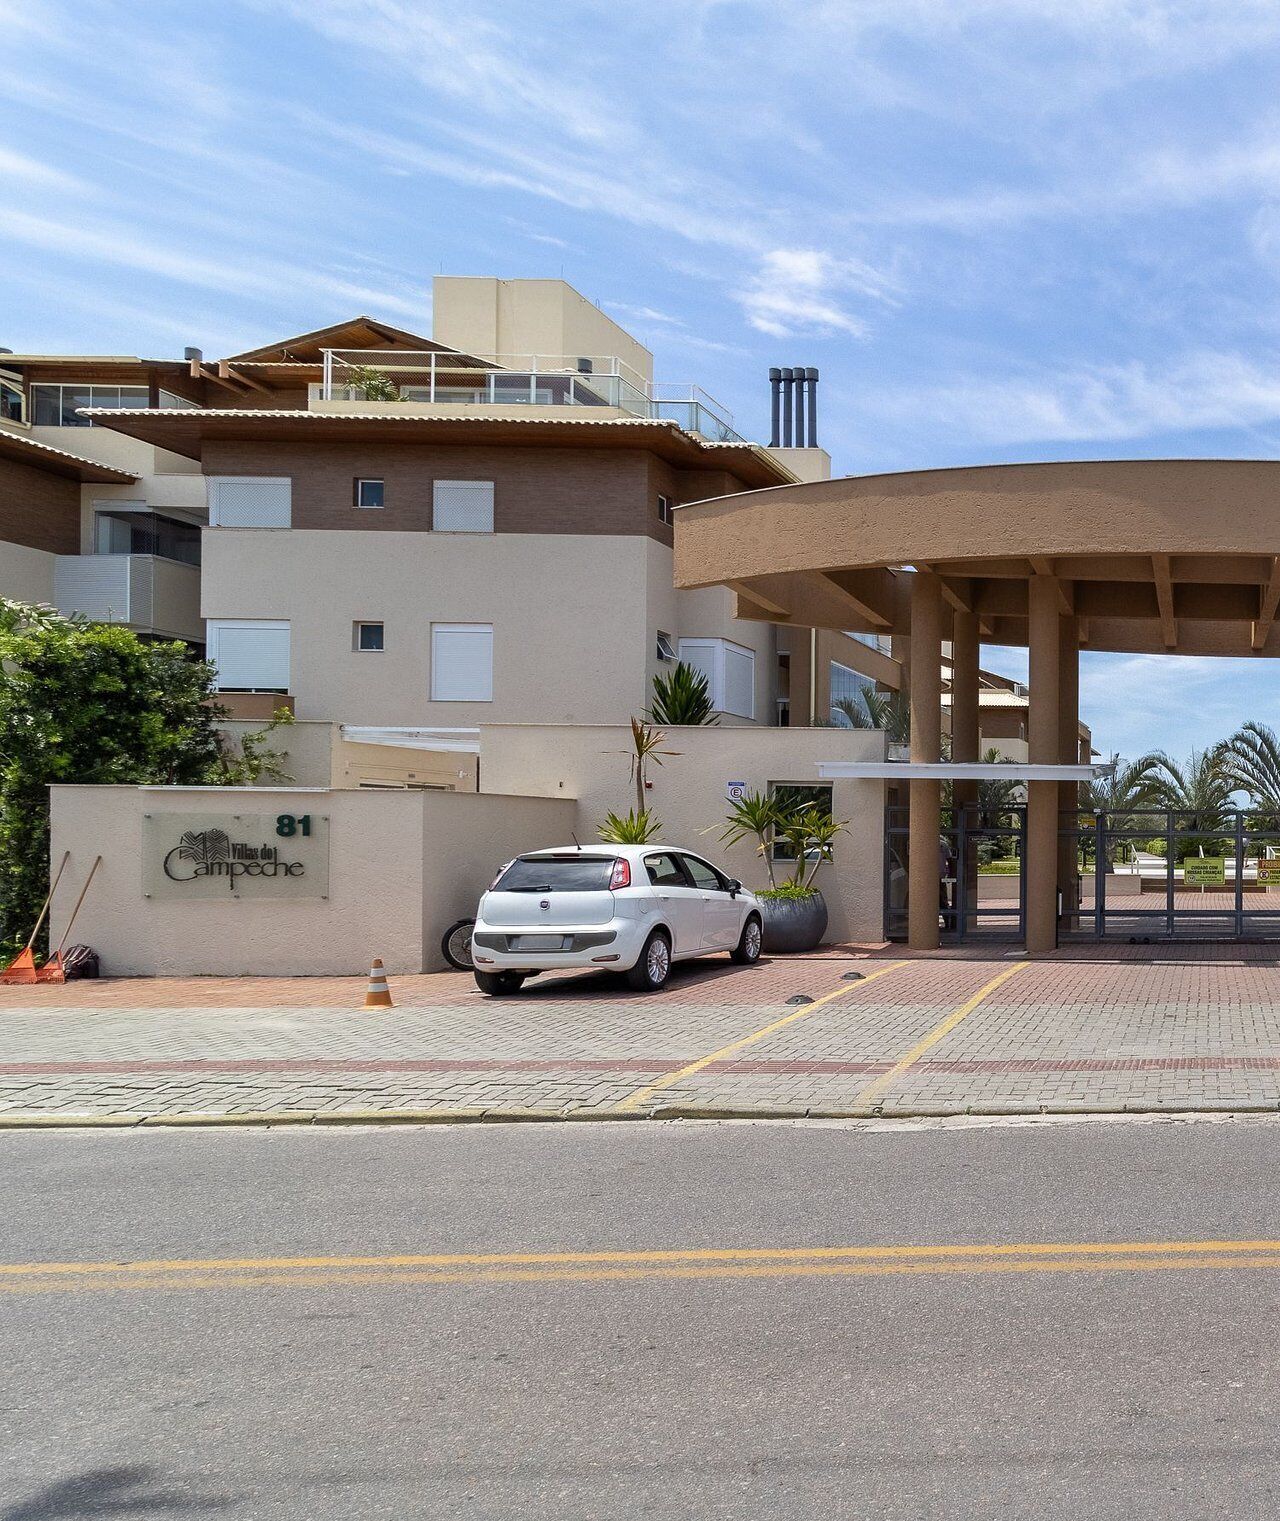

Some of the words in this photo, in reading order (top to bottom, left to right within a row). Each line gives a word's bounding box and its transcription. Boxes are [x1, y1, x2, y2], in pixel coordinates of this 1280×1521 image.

[276, 814, 311, 837] 81
[231, 843, 259, 860] Villas
[260, 843, 273, 860] do
[163, 845, 305, 891] Campeche
